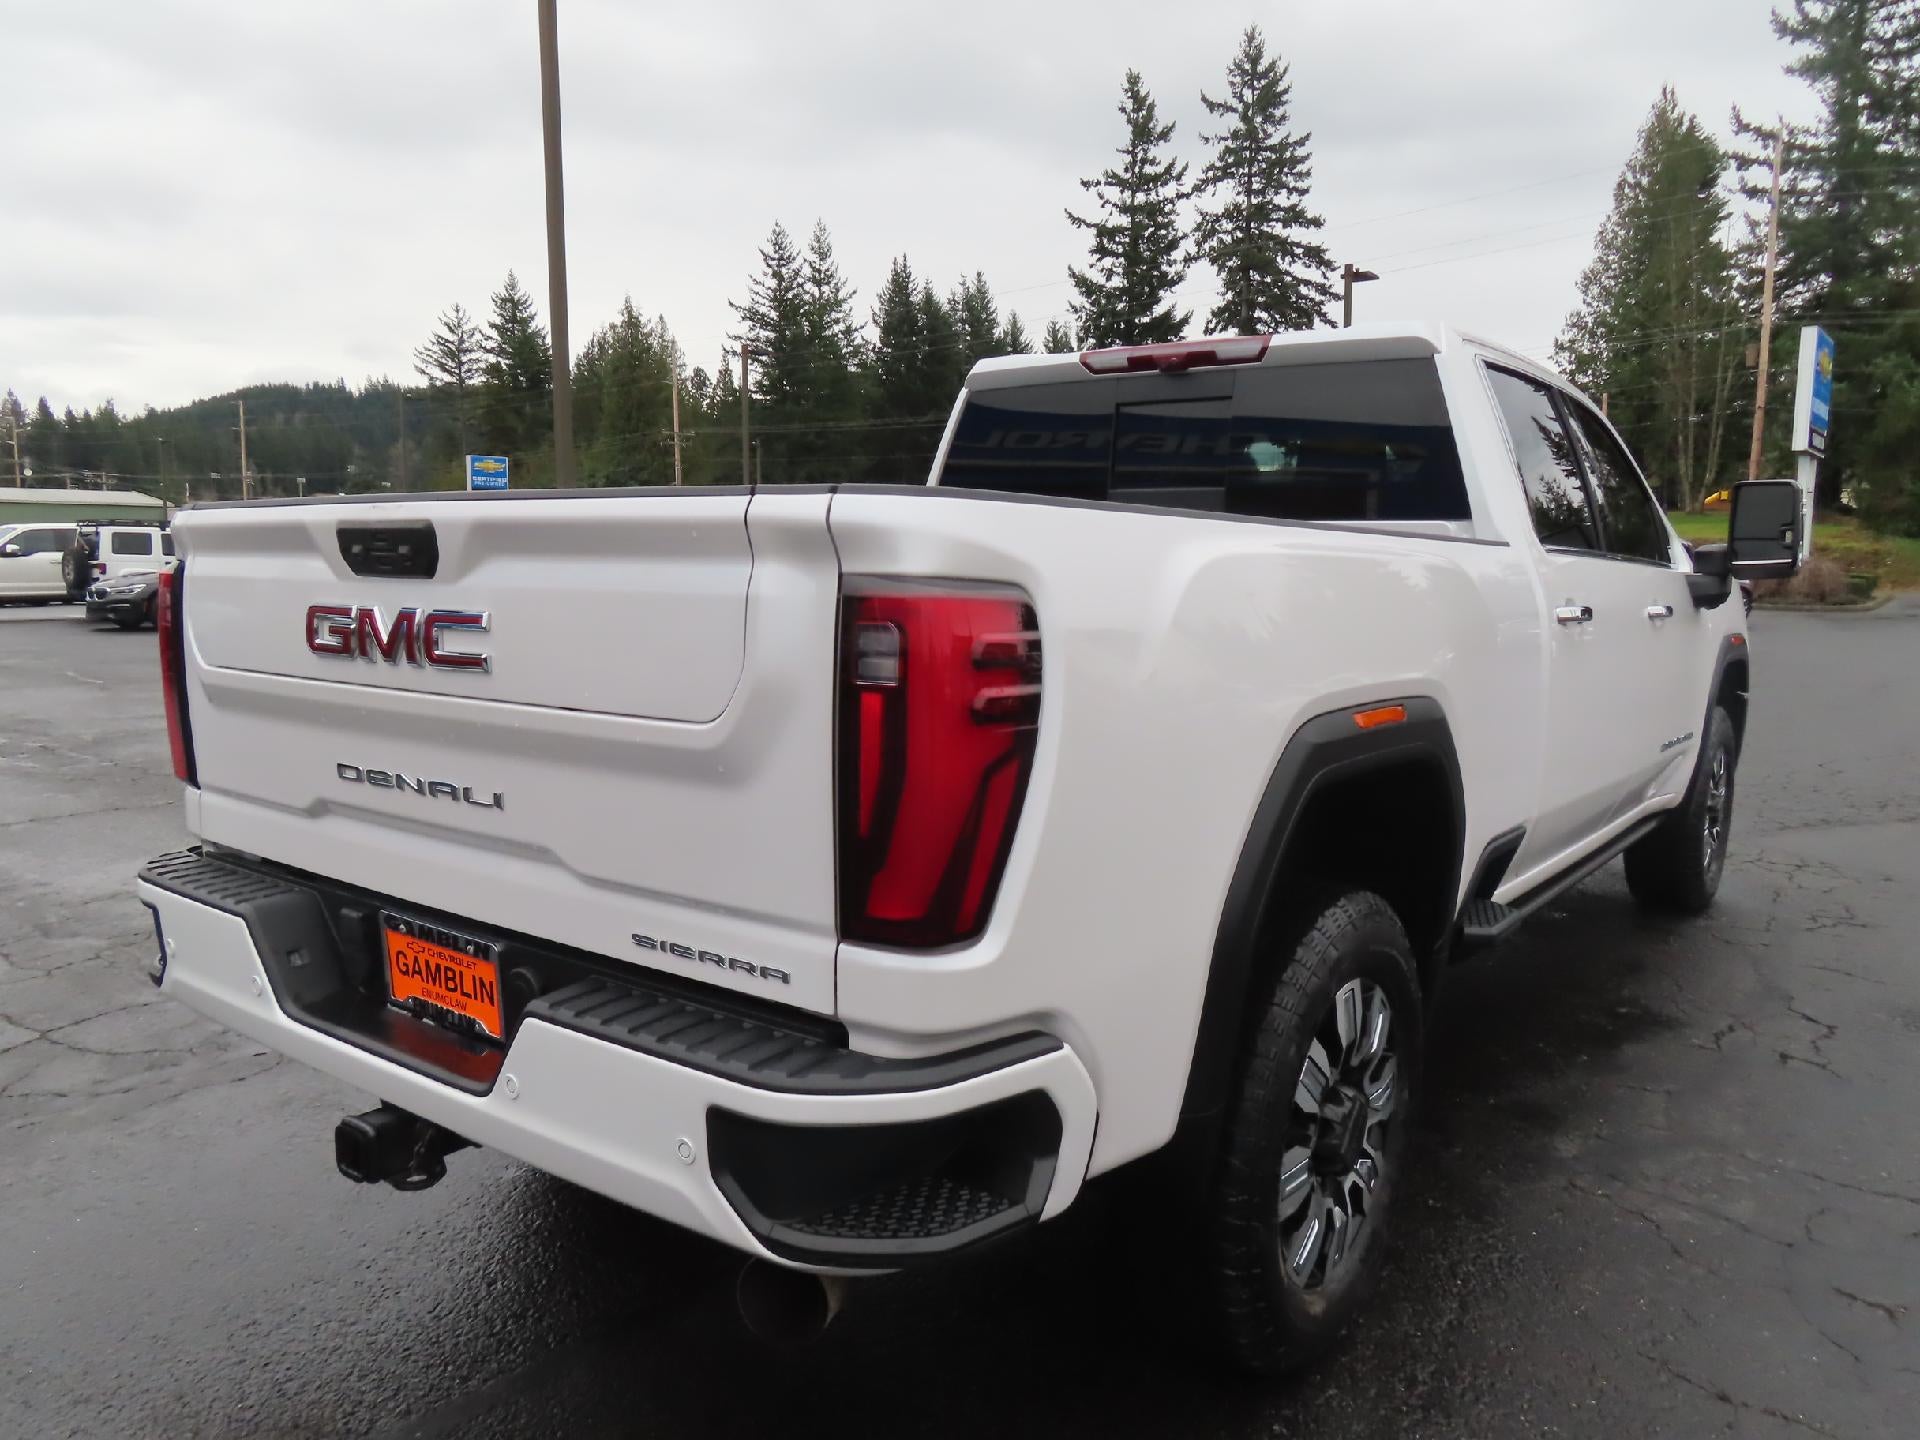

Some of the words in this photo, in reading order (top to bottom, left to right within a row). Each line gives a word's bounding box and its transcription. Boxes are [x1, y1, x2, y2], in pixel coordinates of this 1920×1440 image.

[306, 604, 491, 673] GMC
[336, 763, 505, 810] DENALI
[395, 950, 495, 1007] GAMBLIN
[427, 948, 477, 970] CHEVROLET
[631, 933, 792, 985] SIERRA
